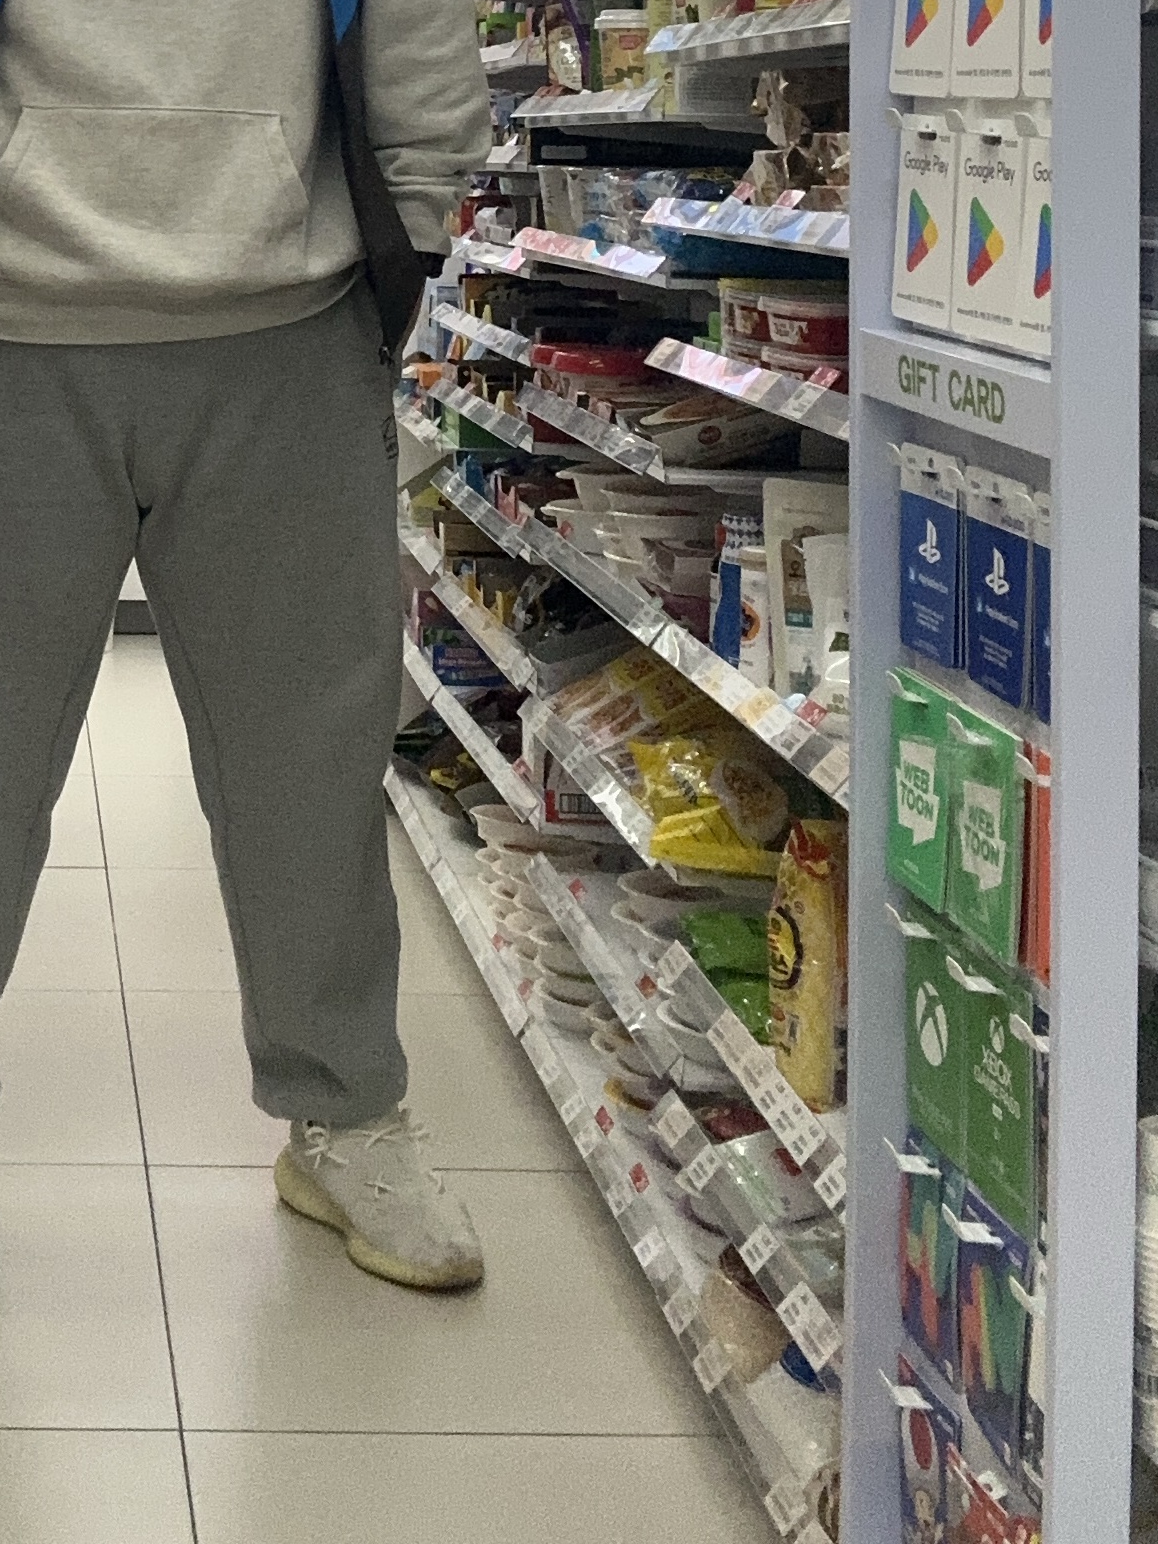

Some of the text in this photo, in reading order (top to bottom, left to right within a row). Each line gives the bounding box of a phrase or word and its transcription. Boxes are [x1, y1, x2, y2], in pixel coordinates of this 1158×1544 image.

[904, 151, 950, 178] Google Play
[964, 157, 1016, 186] Google Play
[898, 355, 1006, 424] GIFT CARD
[904, 760, 931, 794] WEB
[900, 780, 934, 822] TOON
[968, 804, 995, 838] WEB
[964, 823, 1000, 867] TOON
